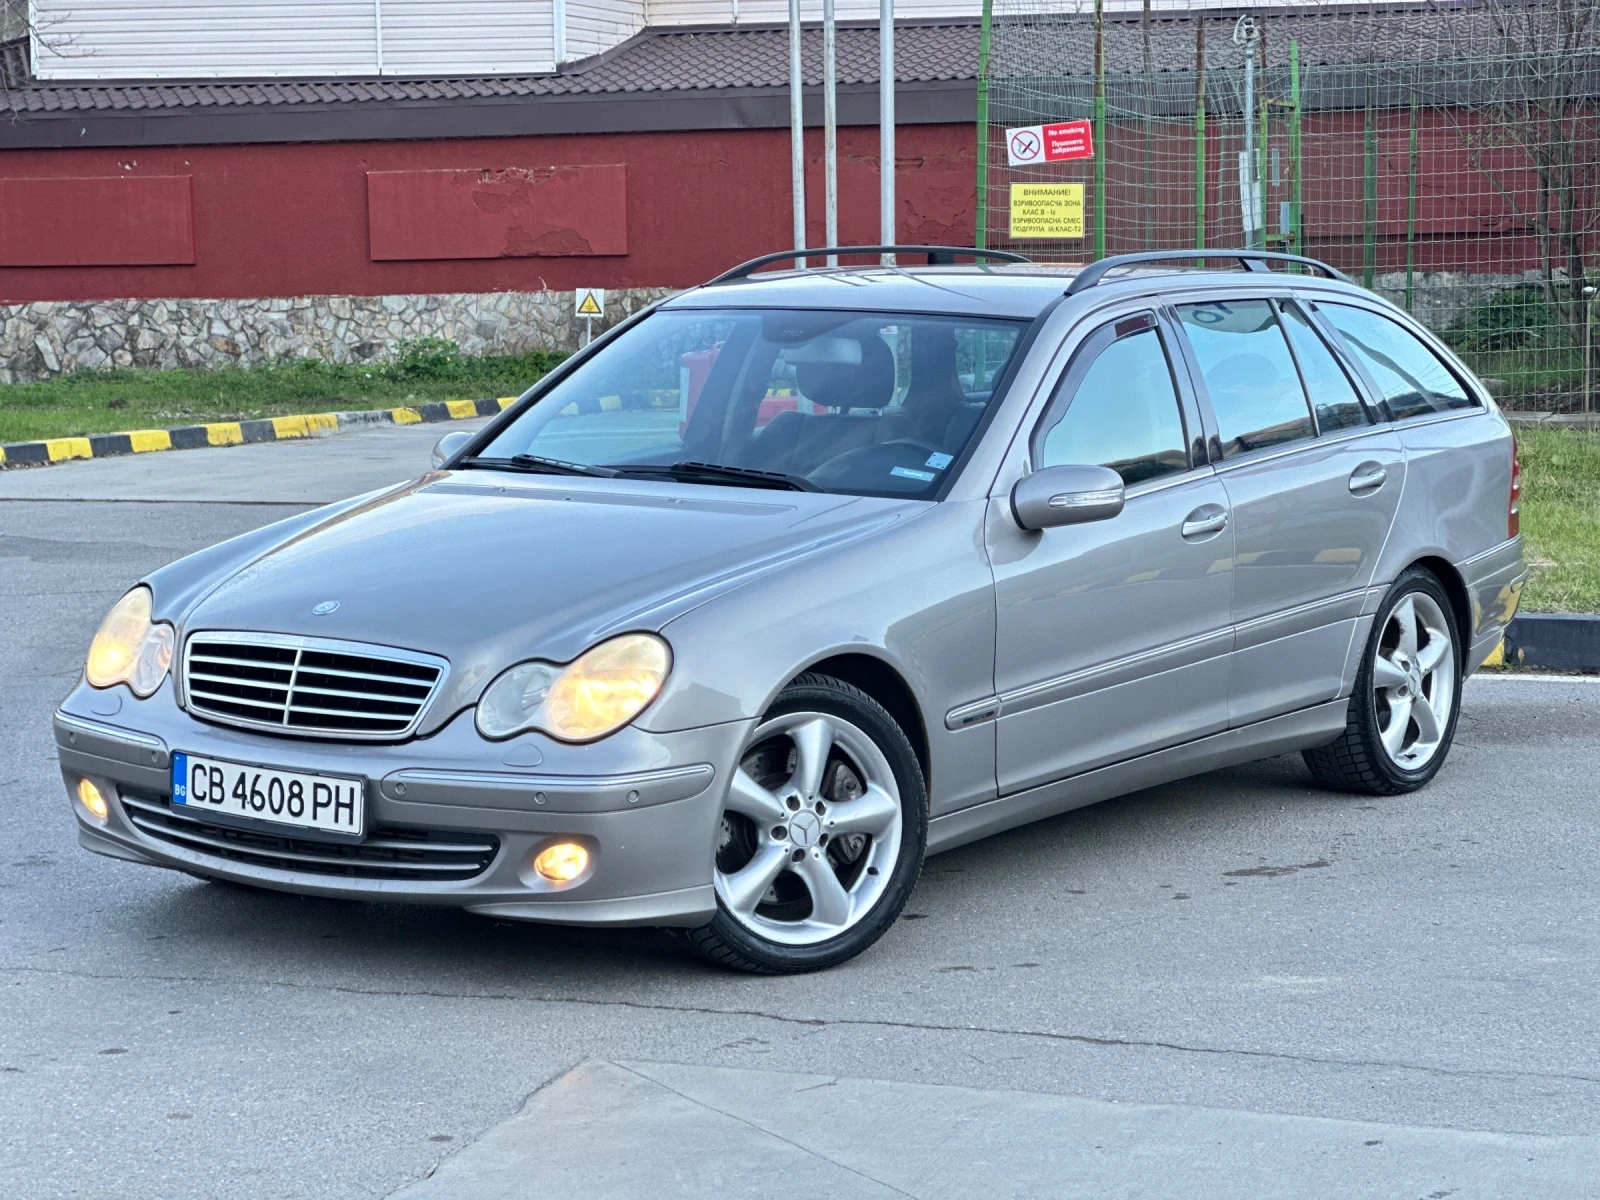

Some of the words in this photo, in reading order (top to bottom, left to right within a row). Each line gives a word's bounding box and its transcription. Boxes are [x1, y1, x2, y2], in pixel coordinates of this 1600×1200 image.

[1059, 126, 1084, 135] smoking
[1052, 139, 1084, 148] Пушенето
[1052, 145, 1084, 154] забранено
[174, 784, 186, 796] BG
[192, 764, 225, 804] CB
[232, 772, 305, 817] 4608
[312, 782, 355, 826] PH
